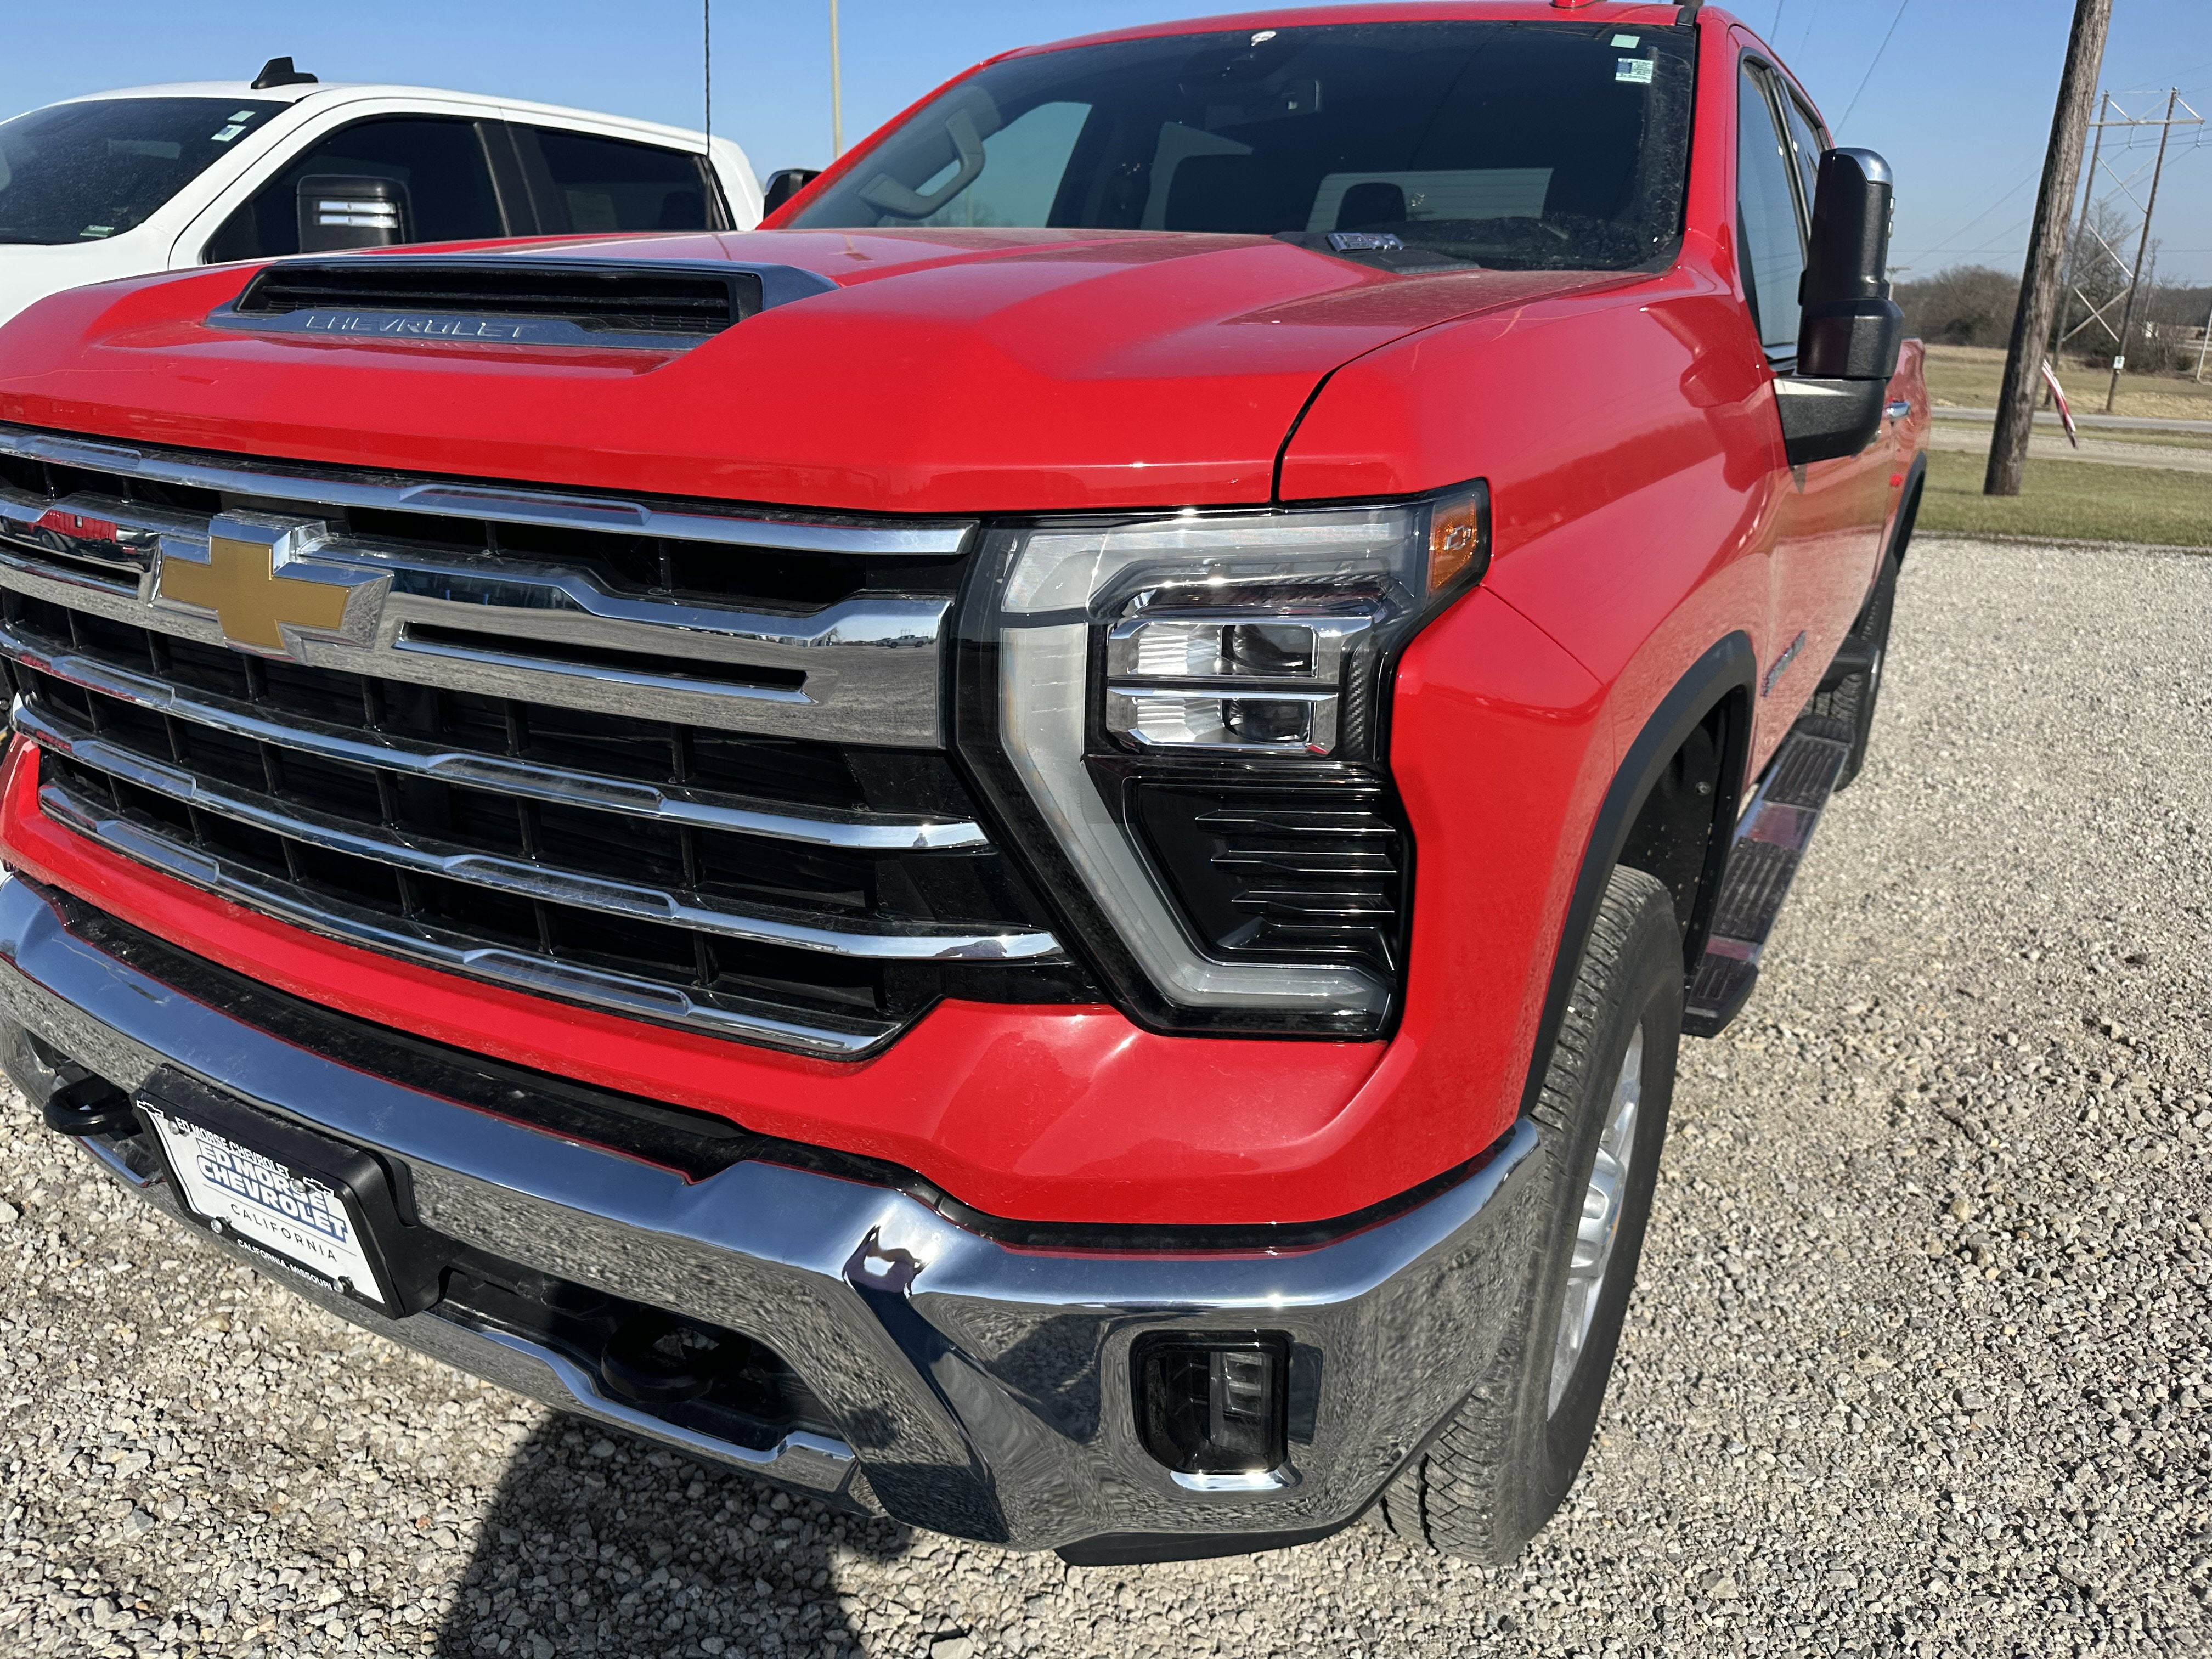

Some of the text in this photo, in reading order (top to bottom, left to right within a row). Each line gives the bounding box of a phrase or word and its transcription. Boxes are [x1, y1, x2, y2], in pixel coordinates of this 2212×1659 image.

[306, 315, 536, 338] CHEVROLET
[174, 1116, 290, 1179] ED MORSE CHEVROLET
[196, 1138, 232, 1169] ED
[197, 1155, 348, 1243] CHEVROLET
[230, 1204, 337, 1262] CALIFORNIA
[237, 1239, 333, 1290] CALIFORNIA, MISSOURI
